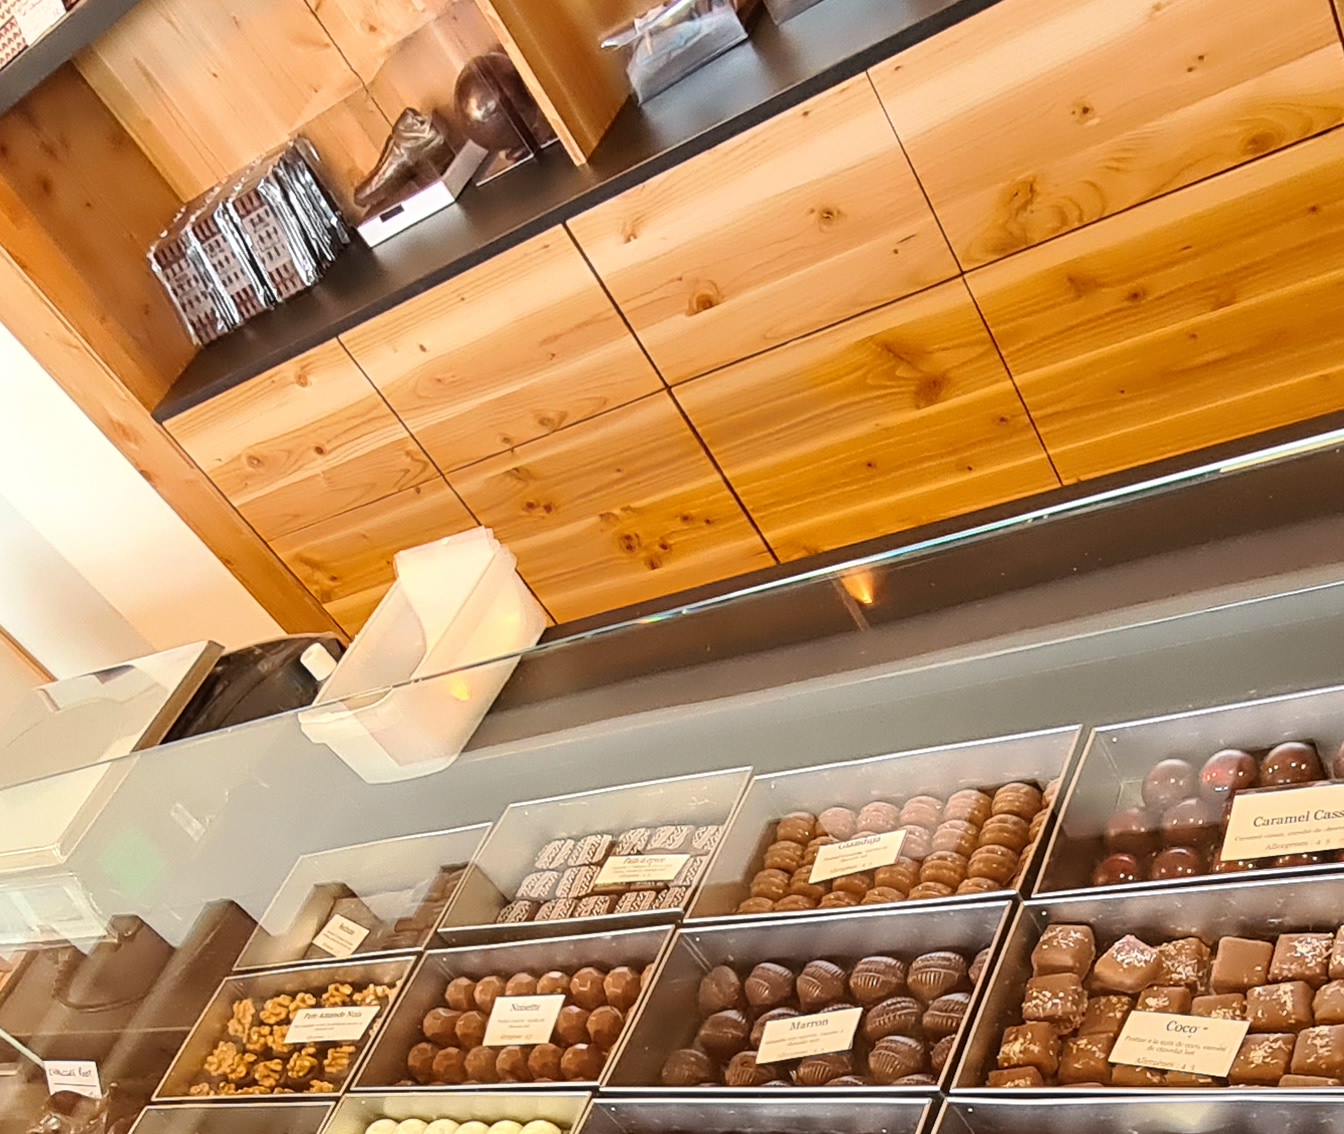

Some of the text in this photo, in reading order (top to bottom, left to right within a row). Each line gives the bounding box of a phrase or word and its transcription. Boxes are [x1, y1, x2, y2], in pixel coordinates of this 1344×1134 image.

[1253, 811, 1310, 828] Caramel
[789, 1018, 829, 1031] Marron
[1166, 1020, 1198, 1034] Coco
